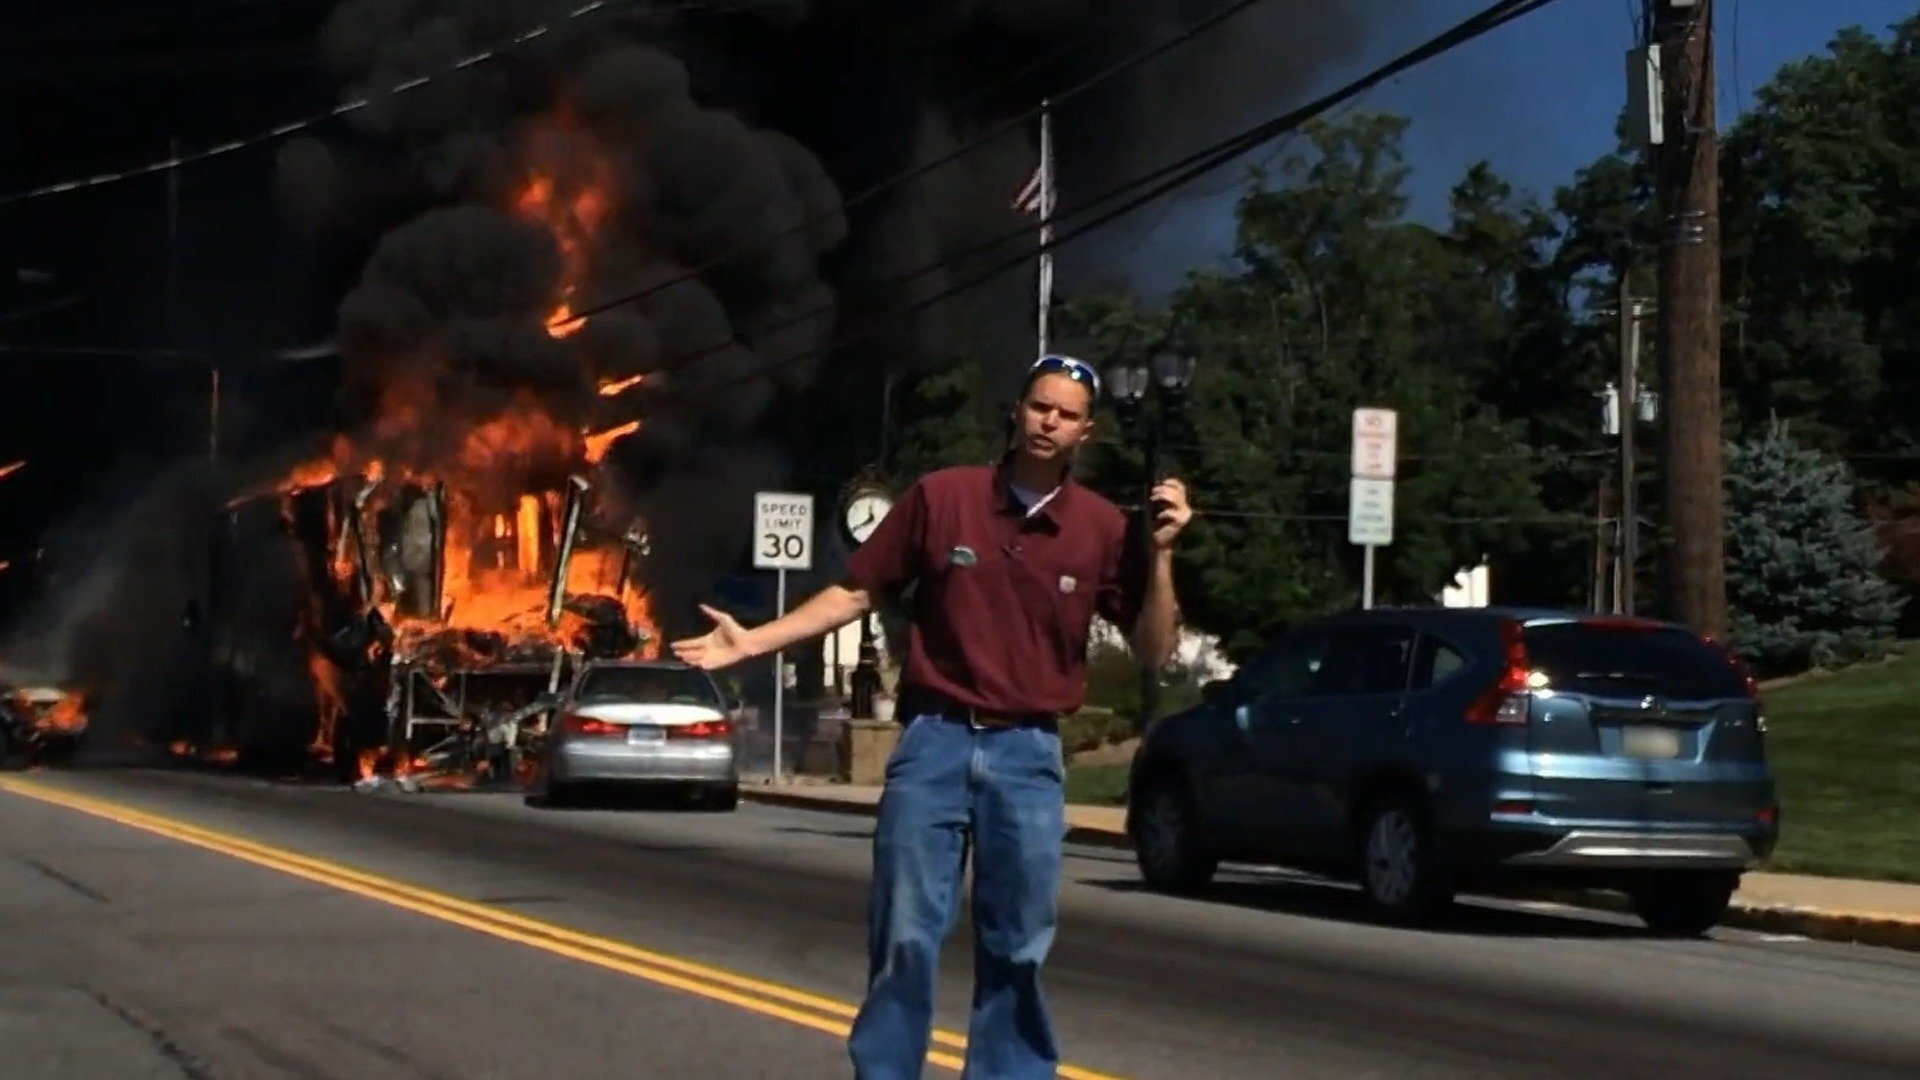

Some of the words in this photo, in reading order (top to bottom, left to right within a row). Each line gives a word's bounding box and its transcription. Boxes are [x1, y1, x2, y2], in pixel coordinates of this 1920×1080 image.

[761, 503, 807, 516] SPEED
[765, 518, 801, 530] LIMIT
[762, 533, 804, 559] 30
